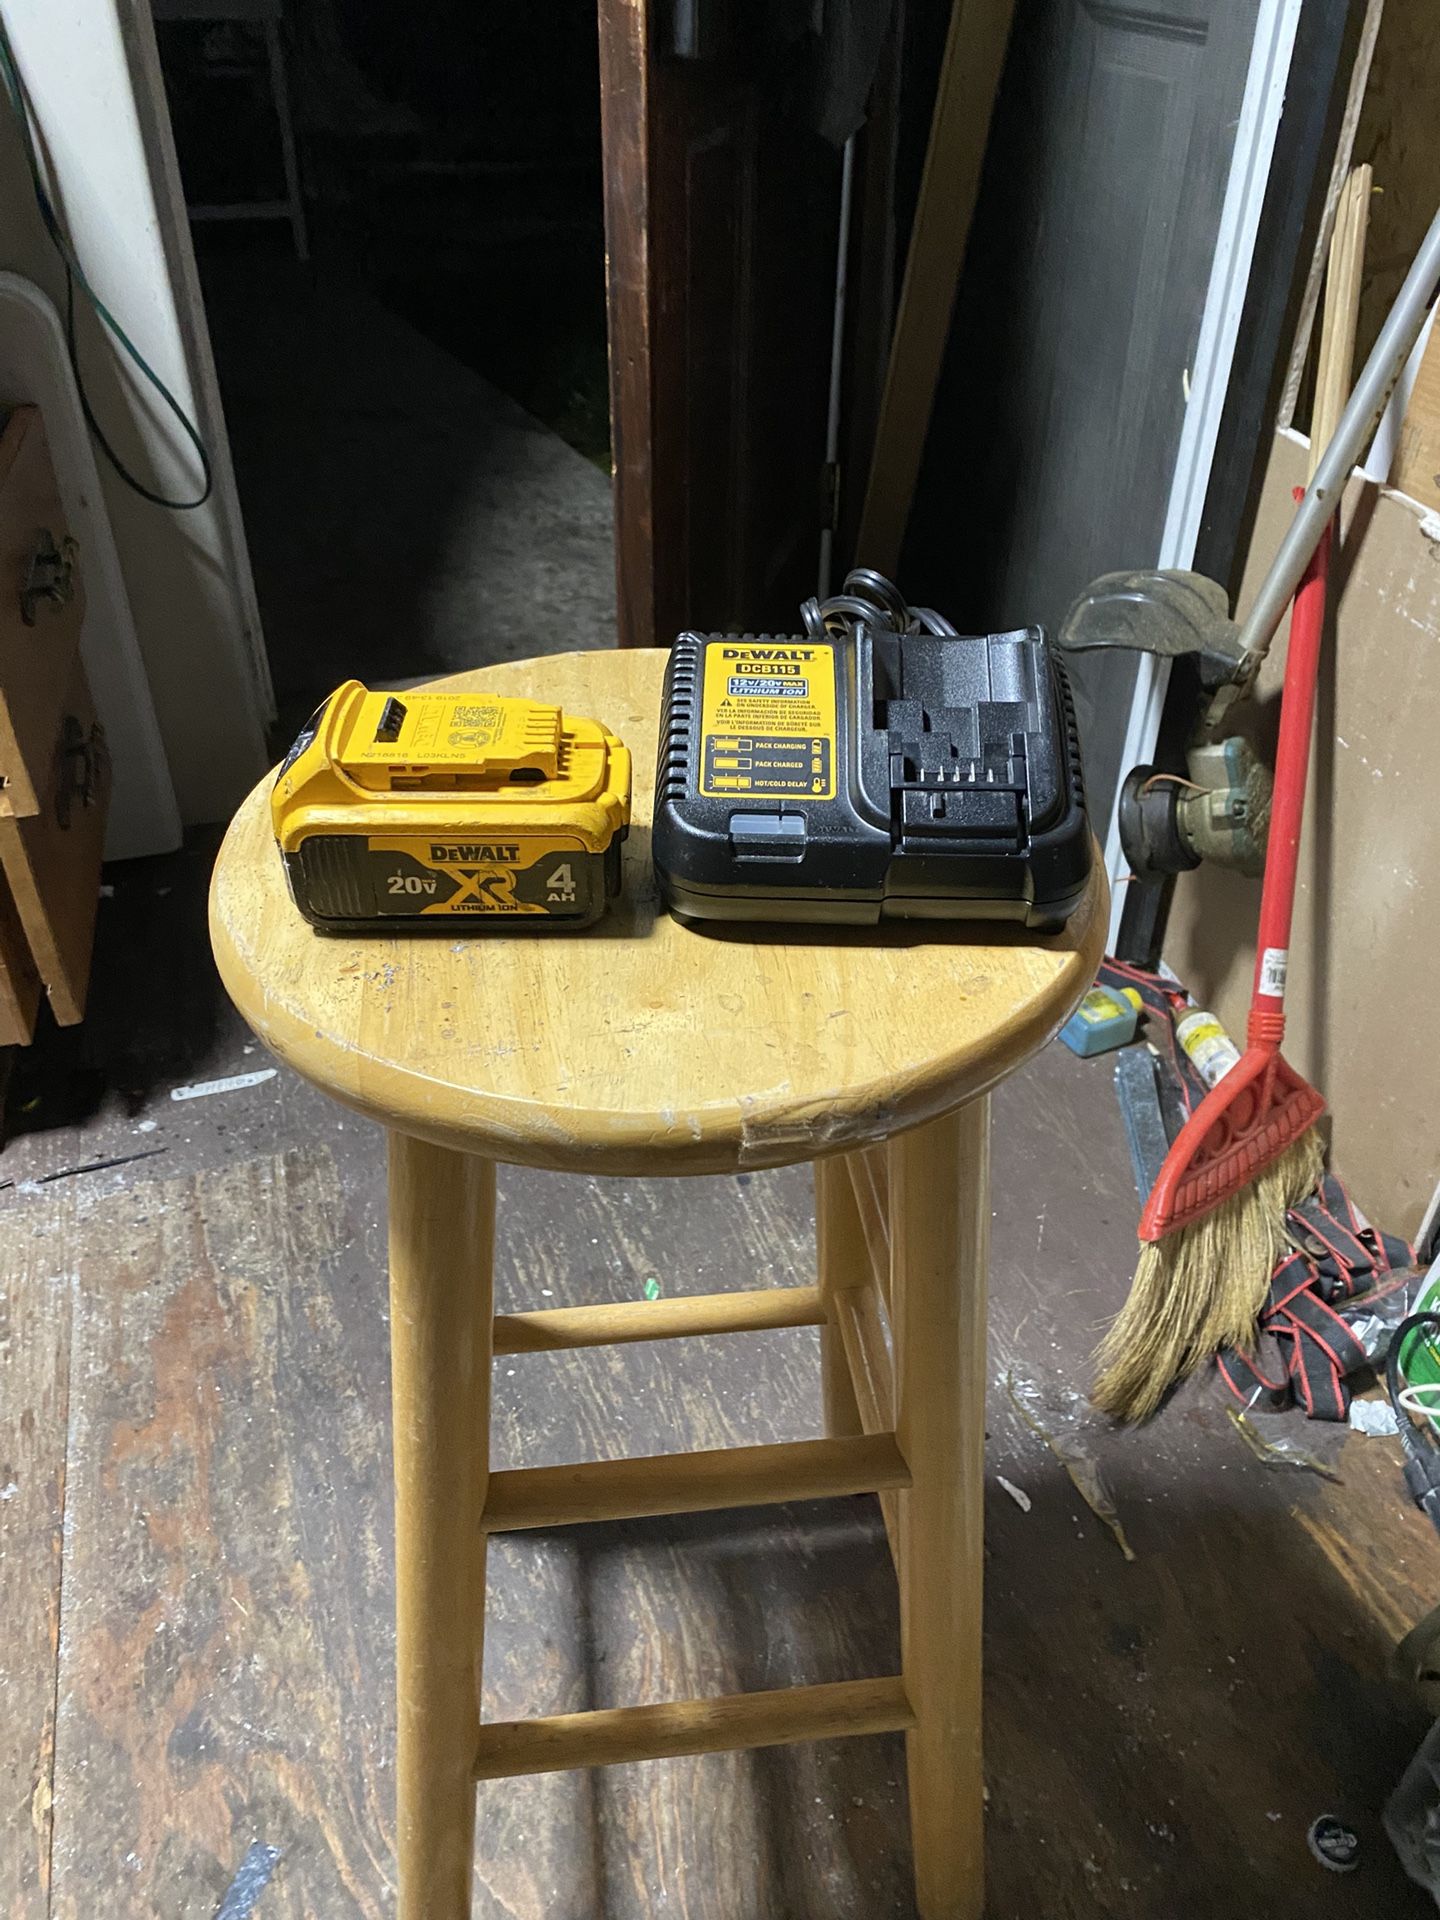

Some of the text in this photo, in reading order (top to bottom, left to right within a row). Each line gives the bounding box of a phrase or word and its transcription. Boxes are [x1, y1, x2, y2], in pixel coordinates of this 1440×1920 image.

[723, 649, 815, 660] DEWALT
[741, 664, 796, 674] DCB115
[732, 687, 779, 695] LITHIUM
[787, 780, 807, 788] DELAY
[430, 845, 520, 861] DEWALT
[546, 863, 576, 893] 4
[547, 893, 575, 902] AH
[451, 903, 519, 912] LITHIUM ION
